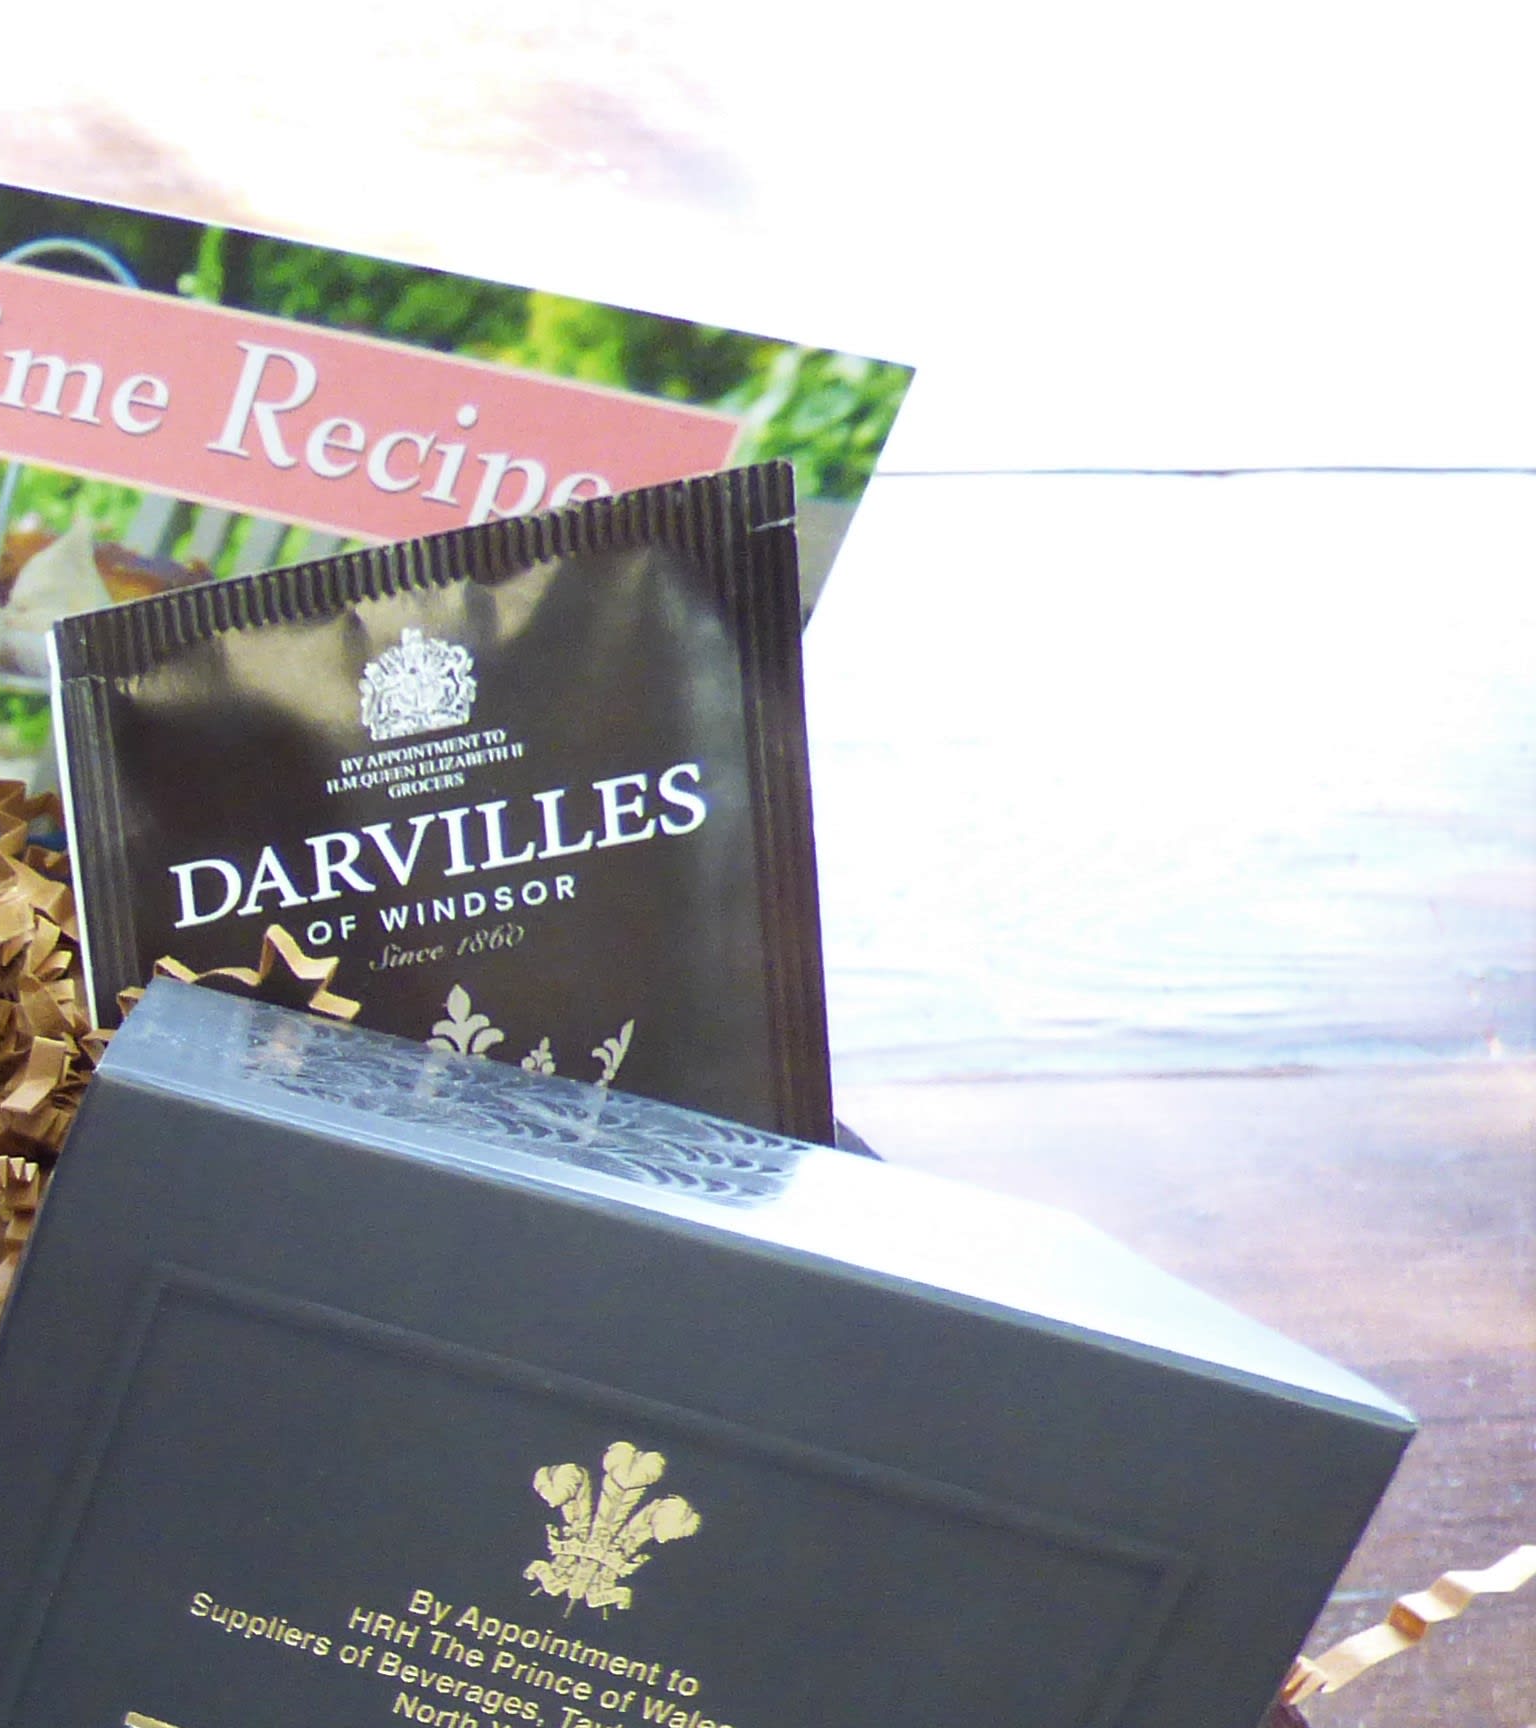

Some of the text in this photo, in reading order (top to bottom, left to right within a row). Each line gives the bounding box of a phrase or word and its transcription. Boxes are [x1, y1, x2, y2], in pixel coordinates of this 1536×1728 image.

[340, 728, 507, 774] BY APPOINTMENT TO
[388, 773, 465, 800] GROCERS
[418, 745, 507, 778] ELIZABETH
[508, 741, 525, 760] II
[168, 763, 708, 929] DARVILLES
[306, 875, 577, 947] OF WINDSOR
[368, 923, 527, 972] Since 1860
[189, 1592, 331, 1660] Suppliers
[339, 1637, 375, 1668] of
[377, 1651, 545, 1728] Beverages,
[348, 1606, 420, 1648] HRH
[426, 1627, 485, 1668] The
[491, 1649, 594, 1700] Prince
[599, 1680, 638, 1713] of
[408, 1589, 701, 1699] By Appointment to
